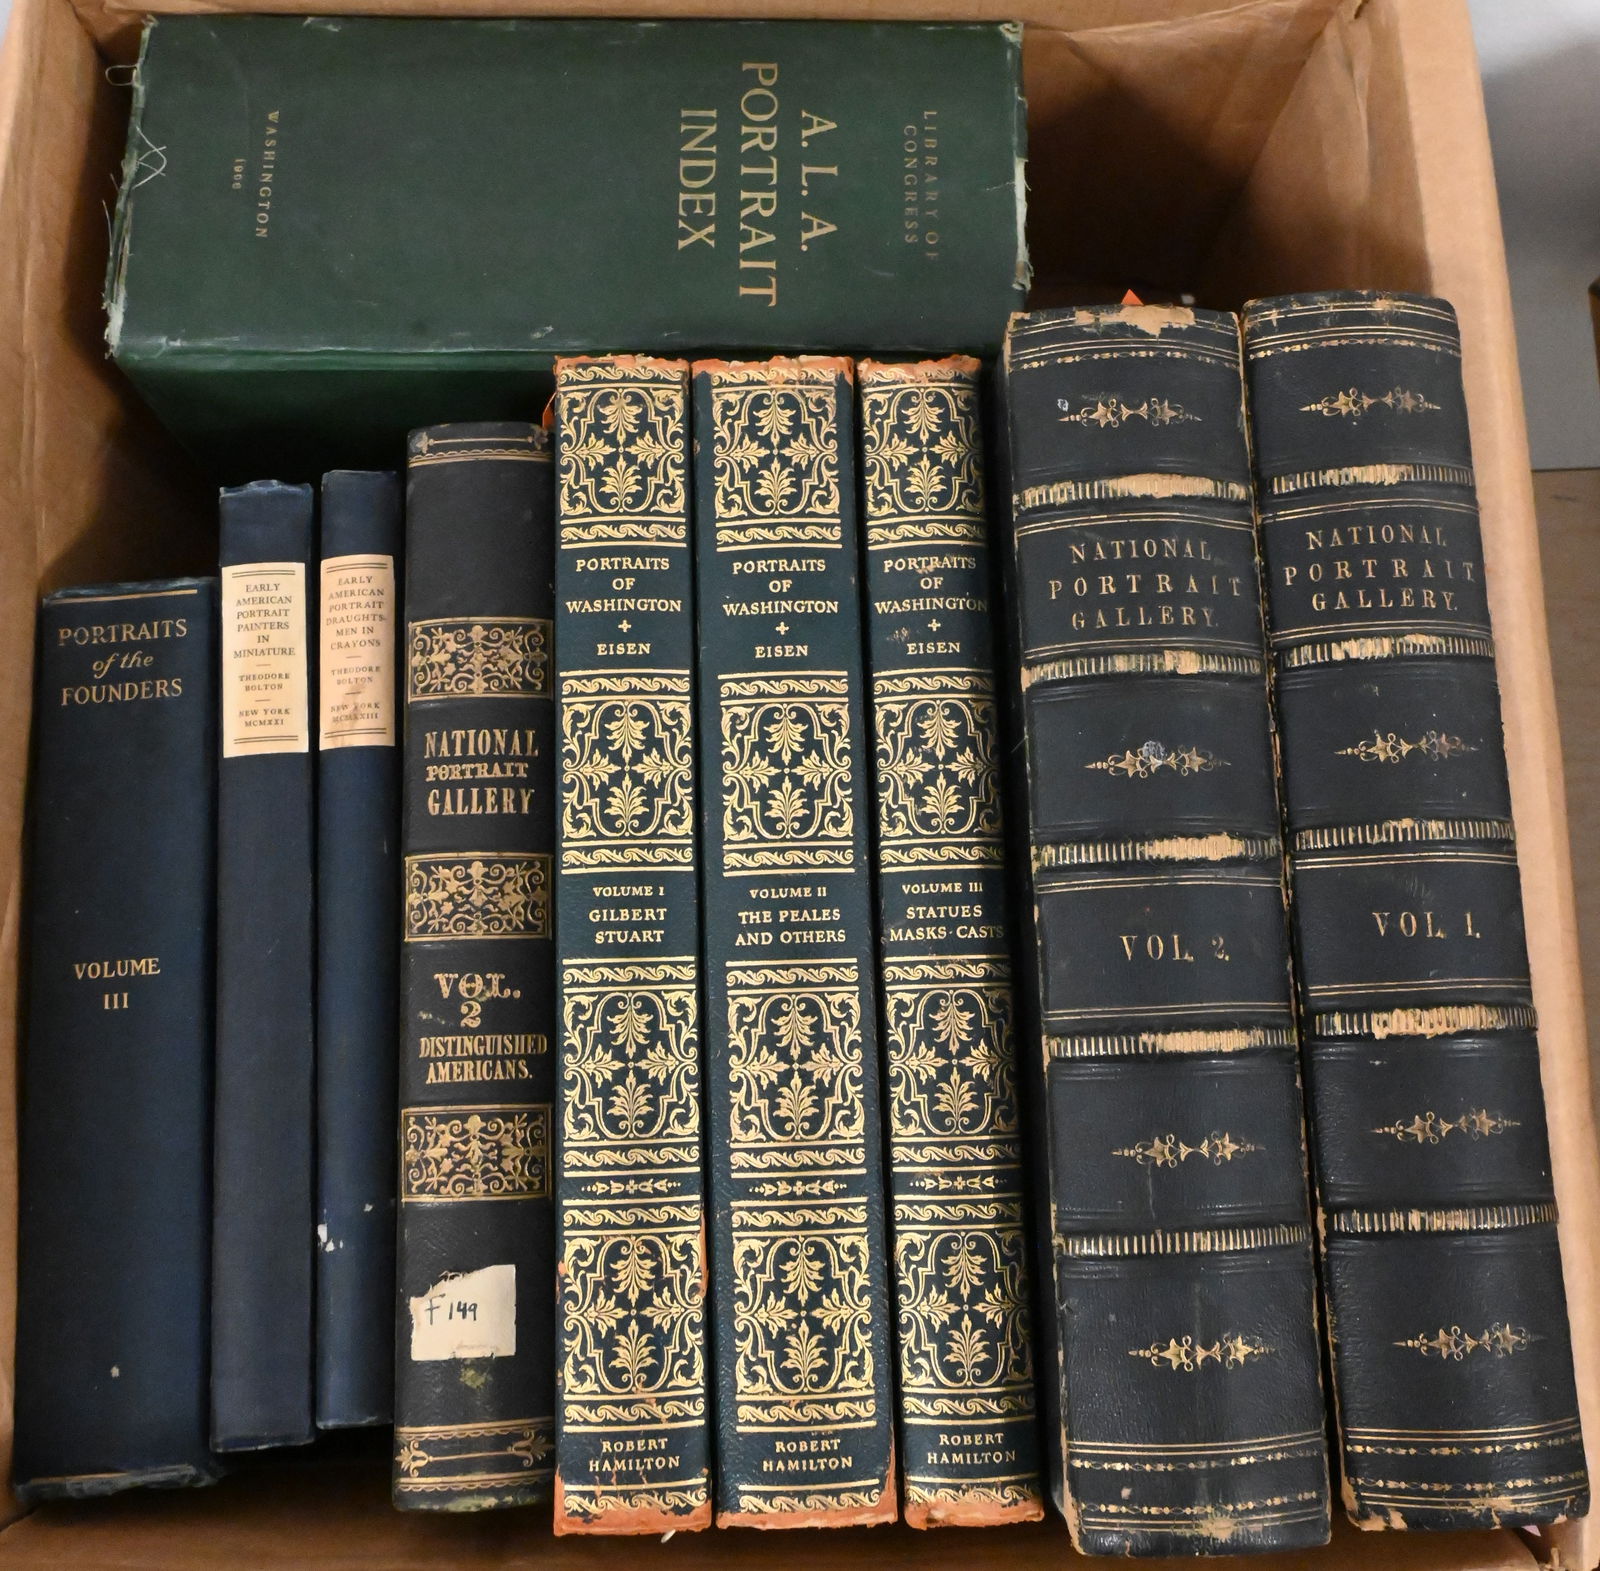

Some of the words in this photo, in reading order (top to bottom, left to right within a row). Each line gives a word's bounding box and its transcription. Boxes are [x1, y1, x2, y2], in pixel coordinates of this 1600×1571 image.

[801, 110, 838, 148] A.
[924, 110, 939, 219] LIBRARY
[255, 110, 280, 239] WASHINGTON
[678, 108, 718, 250] INDEX
[801, 165, 838, 197] L.
[739, 61, 778, 308] PORTRAIT
[903, 124, 919, 245] CONGRESS
[801, 211, 838, 252] A.
[925, 231, 941, 262] OF
[1305, 524, 1448, 550] NATIONAL
[1069, 538, 1212, 564] NATIONAL
[575, 557, 670, 572] PORTRAITS
[732, 559, 826, 575] PORTRAITS
[883, 556, 977, 573] PORTRAITS
[1283, 559, 1475, 586] PORTRAIT
[245, 583, 280, 593] EARLY
[338, 576, 373, 586] EARLY
[612, 577, 636, 591] OF
[768, 579, 793, 593] OF
[920, 577, 944, 589] OF
[1049, 573, 1242, 600] PORTRAIT
[236, 596, 292, 607] AMERICAN
[328, 588, 385, 601] AMERICAN
[1311, 587, 1458, 611] GALLERY.
[329, 601, 384, 613] PORTRAIT
[565, 598, 682, 613] WASHINGTON
[722, 600, 839, 616] WASHINGTON
[874, 597, 988, 614] WASHINGTON
[236, 608, 290, 620] PORTRAIT
[326, 613, 387, 626] DRAUGHTS-
[58, 618, 187, 646] PORTRAITS
[237, 621, 290, 632] PAINTERS
[336, 627, 358, 637] MEN
[362, 626, 374, 635] IN
[256, 634, 270, 644] IN
[330, 638, 381, 650] CRAYONS
[233, 647, 296, 659] MINIATURE
[597, 643, 651, 656] EISEN
[754, 644, 808, 659] EISEN
[907, 642, 961, 655] EISEN
[92, 652, 120, 679] of
[120, 650, 154, 669] the
[331, 665, 381, 676] THEODORE
[238, 672, 291, 682] THEODORE
[336, 676, 374, 686] BOLTON
[60, 678, 183, 706] FOUNDERS
[244, 683, 284, 692] BOLTON
[238, 708, 259, 717] NEW
[263, 708, 291, 716] YORK
[330, 703, 349, 712] NEW
[354, 702, 381, 711] YORK
[244, 718, 284, 728] MCMXXI
[424, 729, 539, 759] NATIONAL
[425, 762, 529, 782] PORTRAIT
[428, 787, 535, 816] GALLERY
[593, 885, 654, 897] VOLUME
[658, 886, 665, 896] I
[749, 887, 812, 899] VOLUME
[817, 886, 827, 897] II
[902, 882, 963, 894] VOLUME
[968, 882, 983, 892] III
[588, 908, 667, 923] GILBERT
[737, 911, 773, 925] THE
[778, 908, 841, 923] PEALES
[906, 905, 983, 920] STATUES
[1371, 911, 1446, 939] VOL.
[594, 930, 665, 944] STUART
[735, 931, 773, 946] AND
[779, 929, 846, 944] OTHERS
[889, 926, 947, 942] MASKS
[956, 925, 1005, 940] CASTS
[1211, 934, 1230, 962] 2.
[73, 957, 161, 980] VOLUME
[434, 973, 521, 999] VOL.
[103, 992, 129, 1010] III
[460, 1000, 482, 1028] 2
[419, 1034, 547, 1058] DISTINGUISHED
[425, 1059, 533, 1084] AMERICANS.
[425, 1293, 446, 1325] F
[448, 1301, 478, 1321] 149
[602, 1438, 668, 1453] ROBERT
[775, 1438, 841, 1453] ROBERT
[939, 1432, 1004, 1446] ROBERT
[588, 1455, 681, 1472] HAMILTON
[762, 1456, 853, 1472] HAMILTON
[927, 1449, 1016, 1465] HAMILTON
